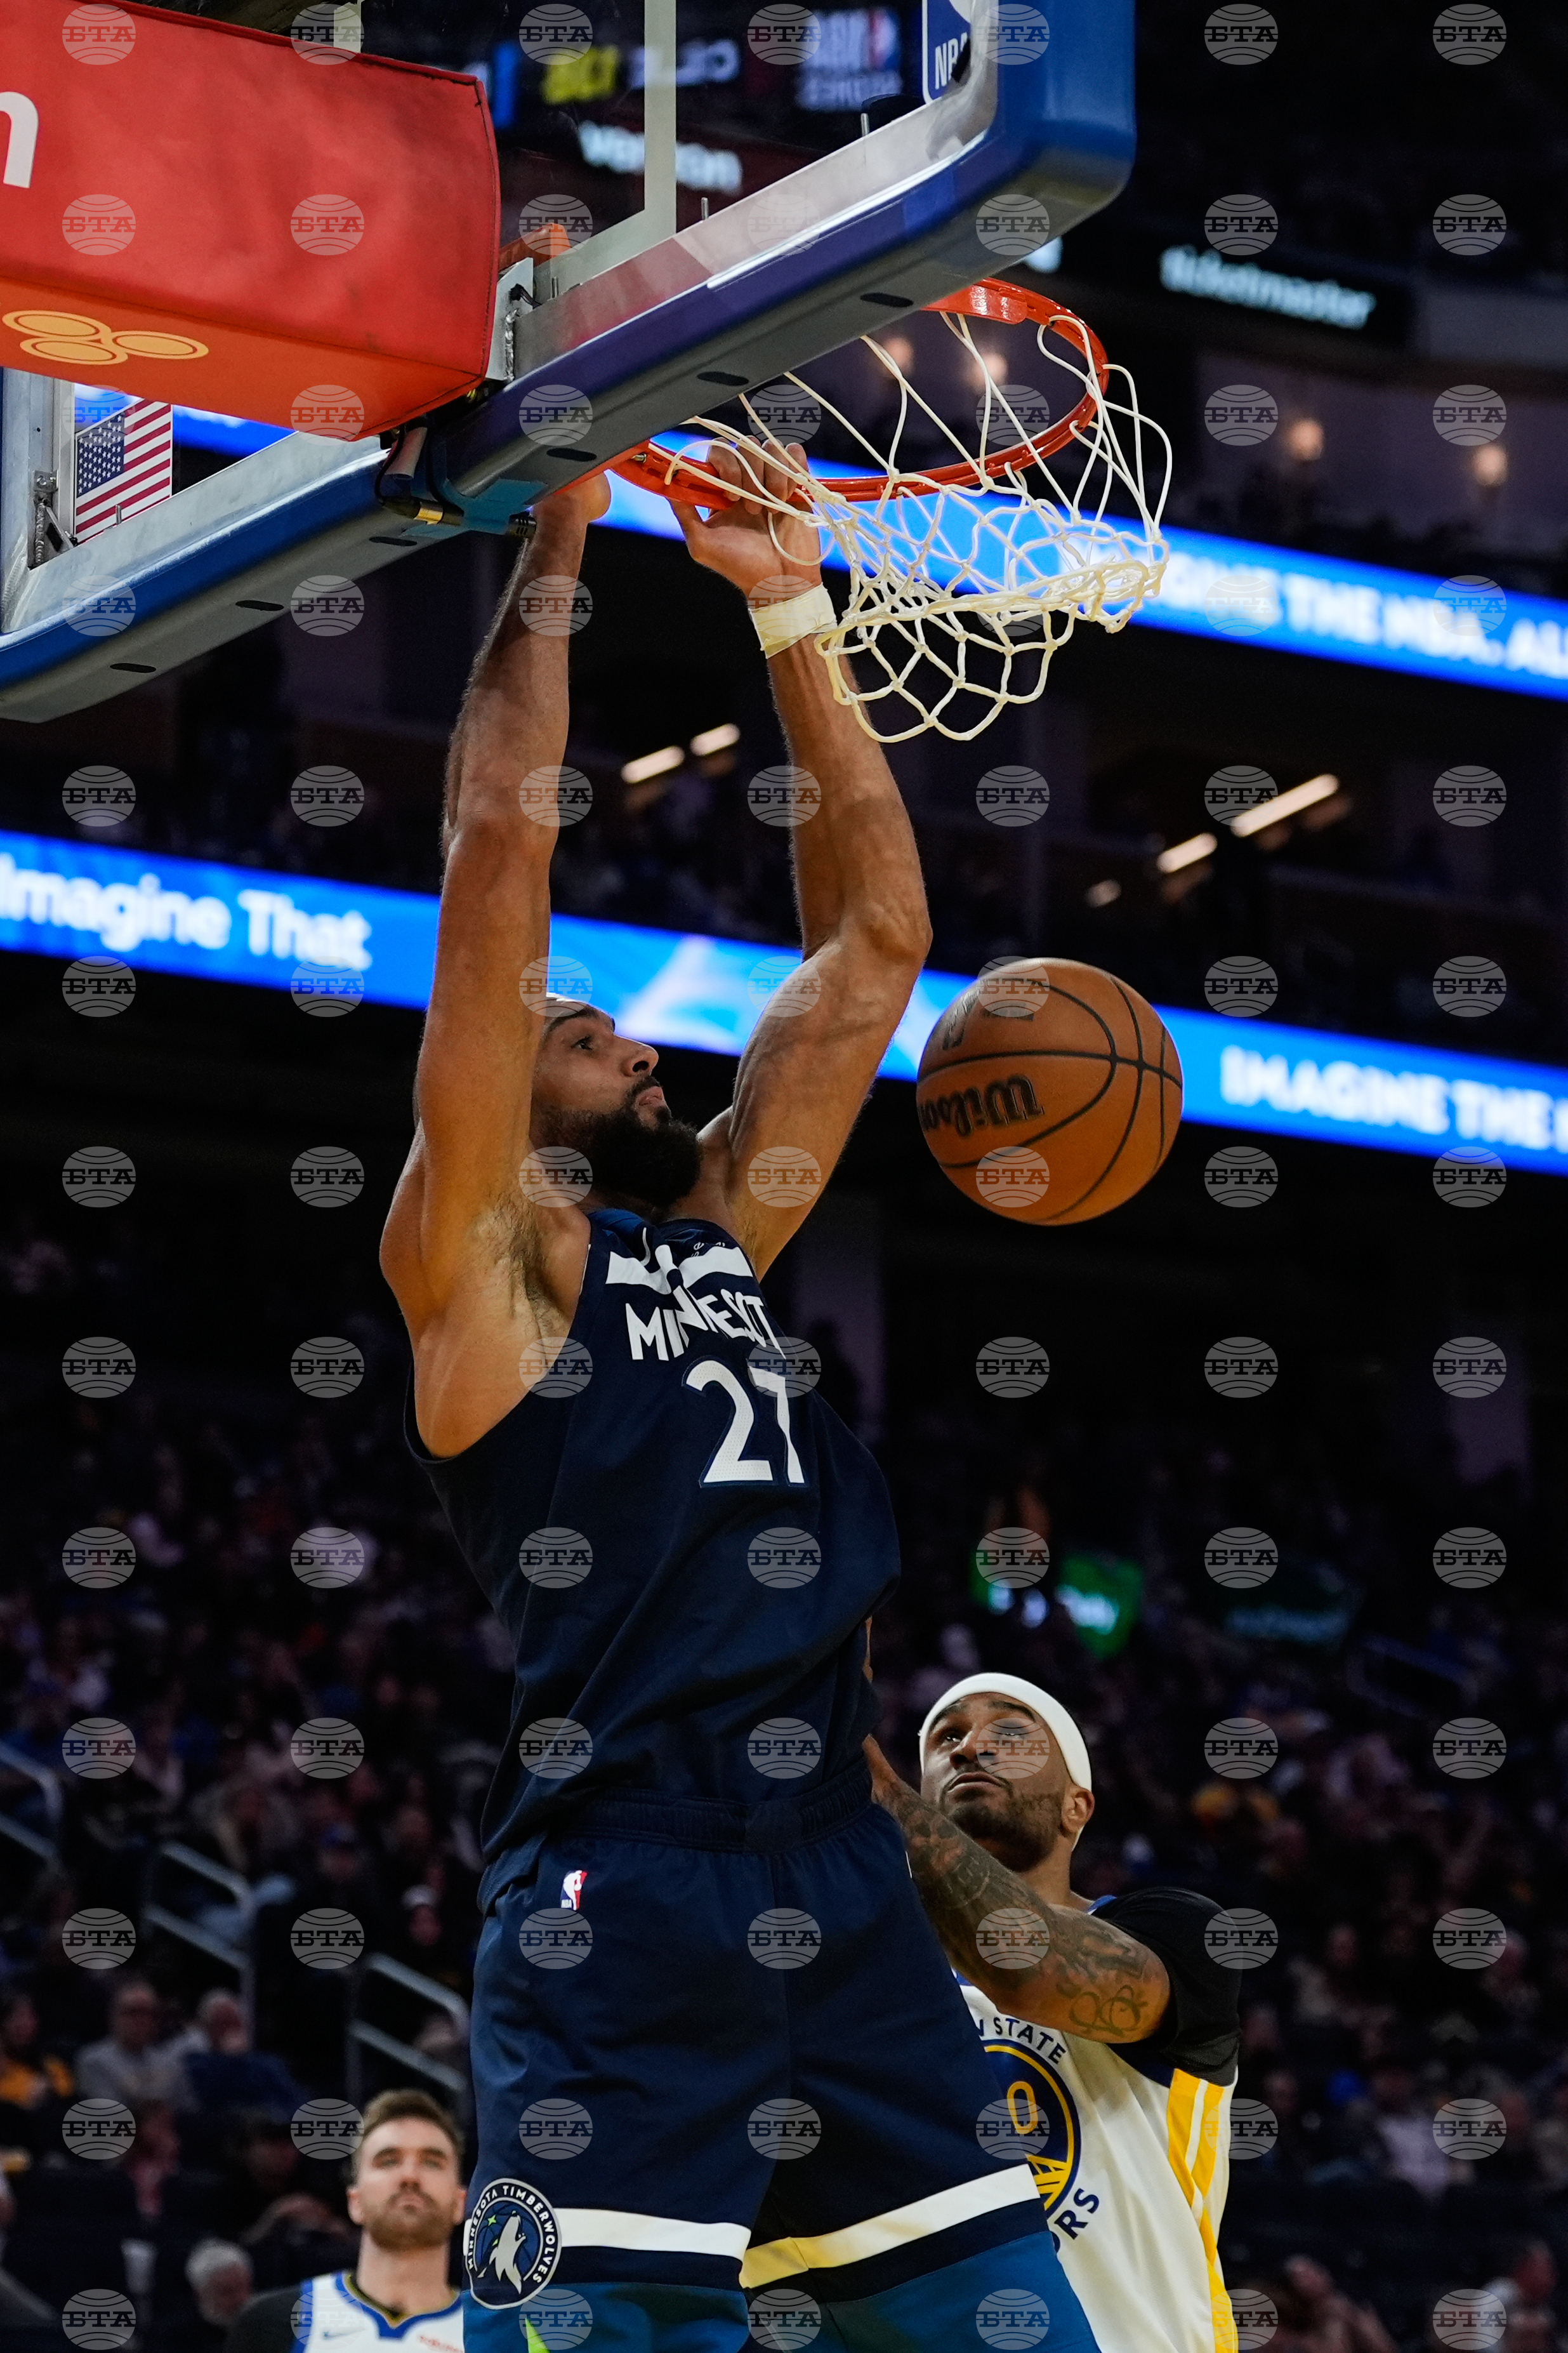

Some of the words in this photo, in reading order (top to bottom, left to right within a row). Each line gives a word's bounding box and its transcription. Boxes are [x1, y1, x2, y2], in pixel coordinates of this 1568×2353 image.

[1283, 573, 1382, 646] THE
[238, 889, 371, 971] That
[1220, 1045, 1449, 1134] IMAGINE
[1450, 1079, 1553, 1150] THE
[686, 1360, 805, 1484] 27
[994, 2017, 1066, 2065] STATE
[1006, 2081, 1038, 2135] 0
[468, 2189, 497, 2270] MINNESOTA
[503, 2185, 556, 2283] TIMBERWOLVES
